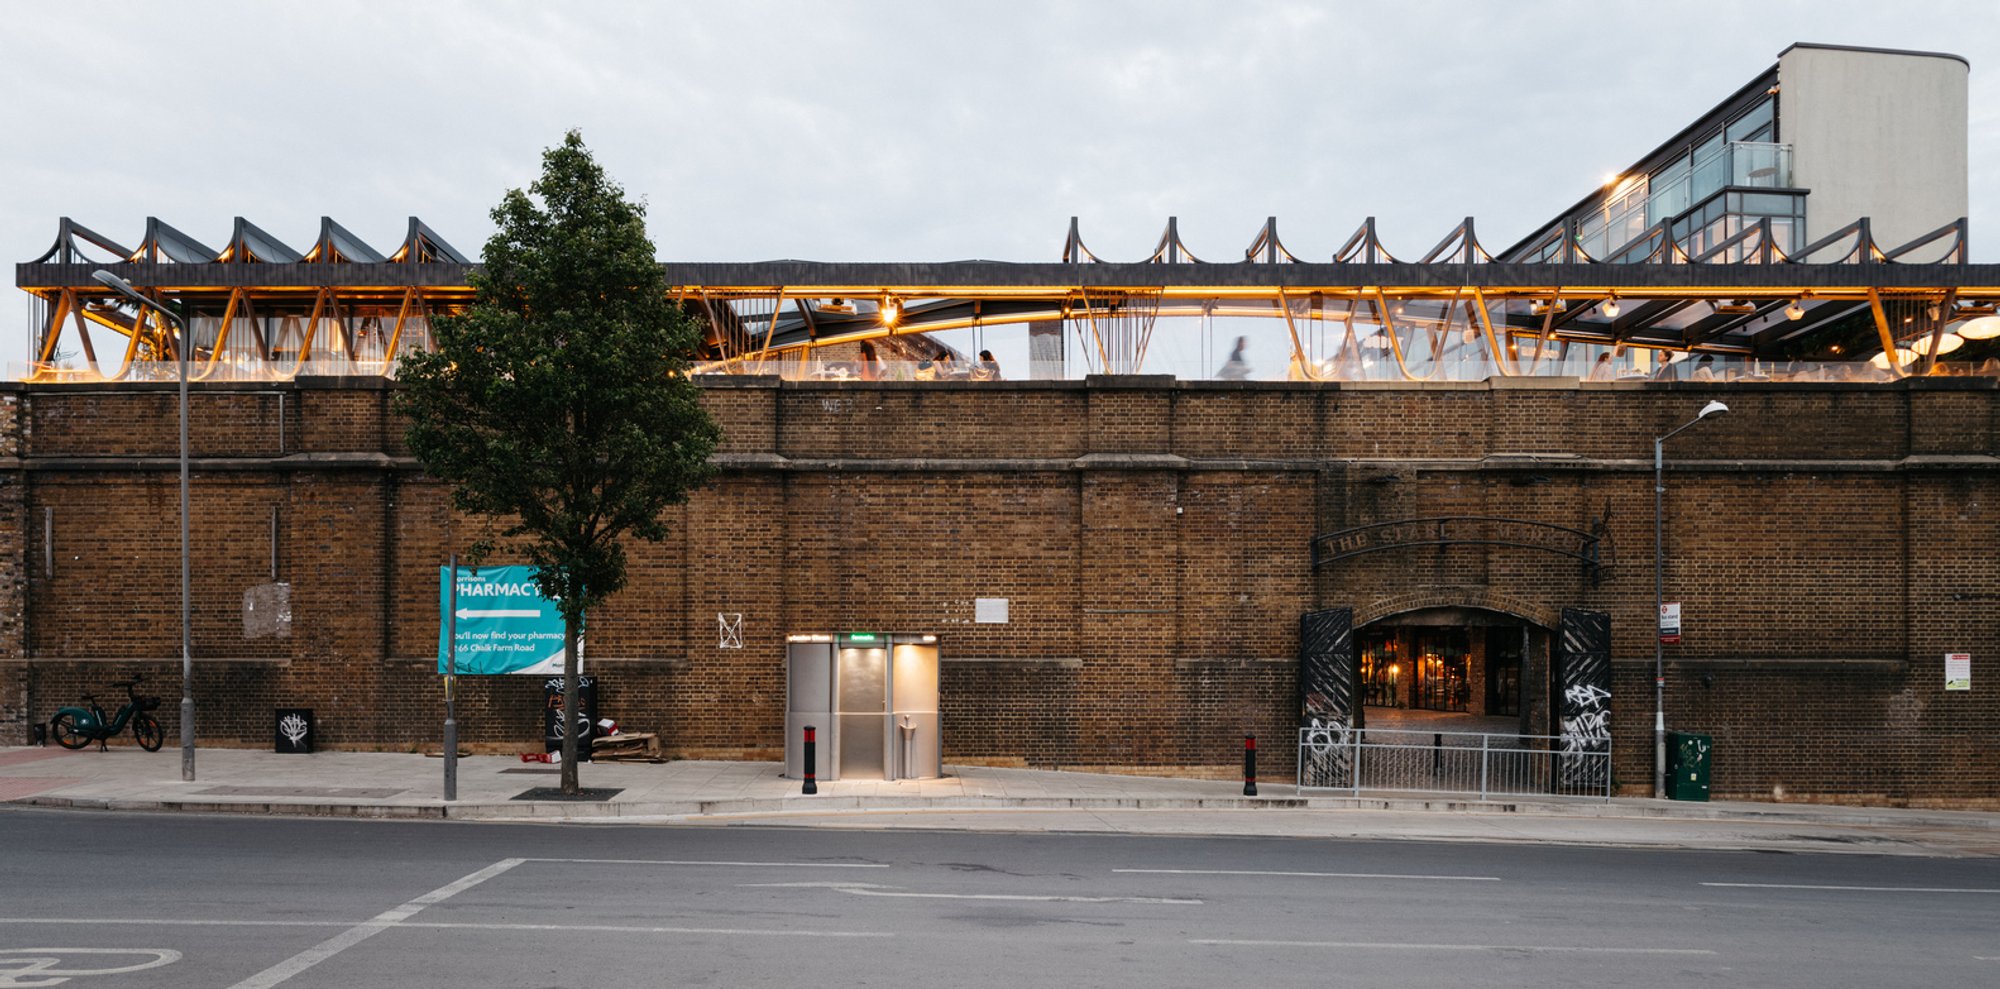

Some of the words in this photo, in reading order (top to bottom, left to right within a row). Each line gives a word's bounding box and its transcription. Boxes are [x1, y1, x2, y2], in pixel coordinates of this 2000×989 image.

[1326, 533, 1368, 555] THE
[1380, 522, 1479, 544] STABL
[455, 631, 470, 640] ou'll
[491, 631, 506, 640] find
[508, 633, 526, 641] your
[528, 632, 565, 641] pharmacy
[459, 644, 469, 652] 66
[470, 644, 491, 652] Chalk
[492, 644, 513, 652] Farm
[514, 644, 535, 652] Road
